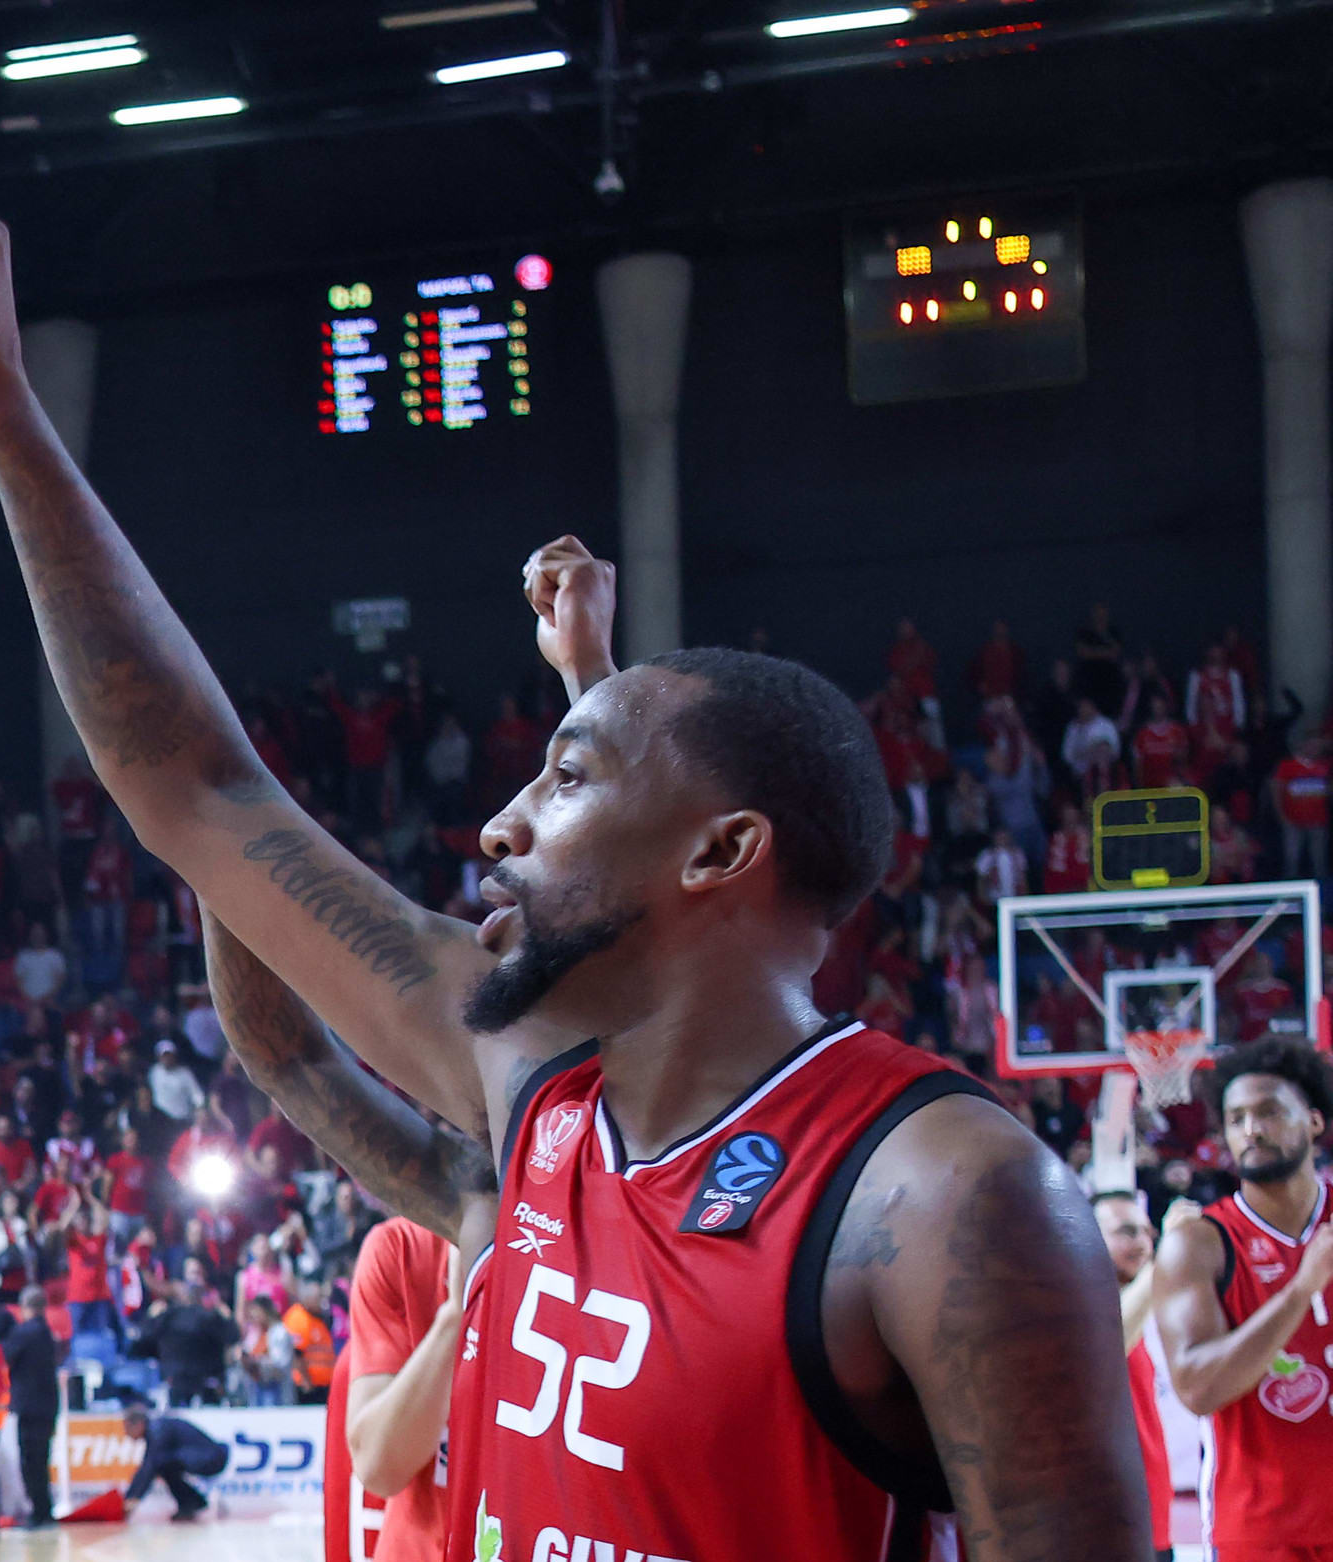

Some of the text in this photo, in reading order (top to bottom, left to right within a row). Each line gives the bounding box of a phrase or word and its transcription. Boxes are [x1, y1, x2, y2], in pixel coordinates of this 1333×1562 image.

[703, 1189, 752, 1204] EuroCup
[513, 1202, 565, 1237] Reebok
[495, 1263, 652, 1472] 52
